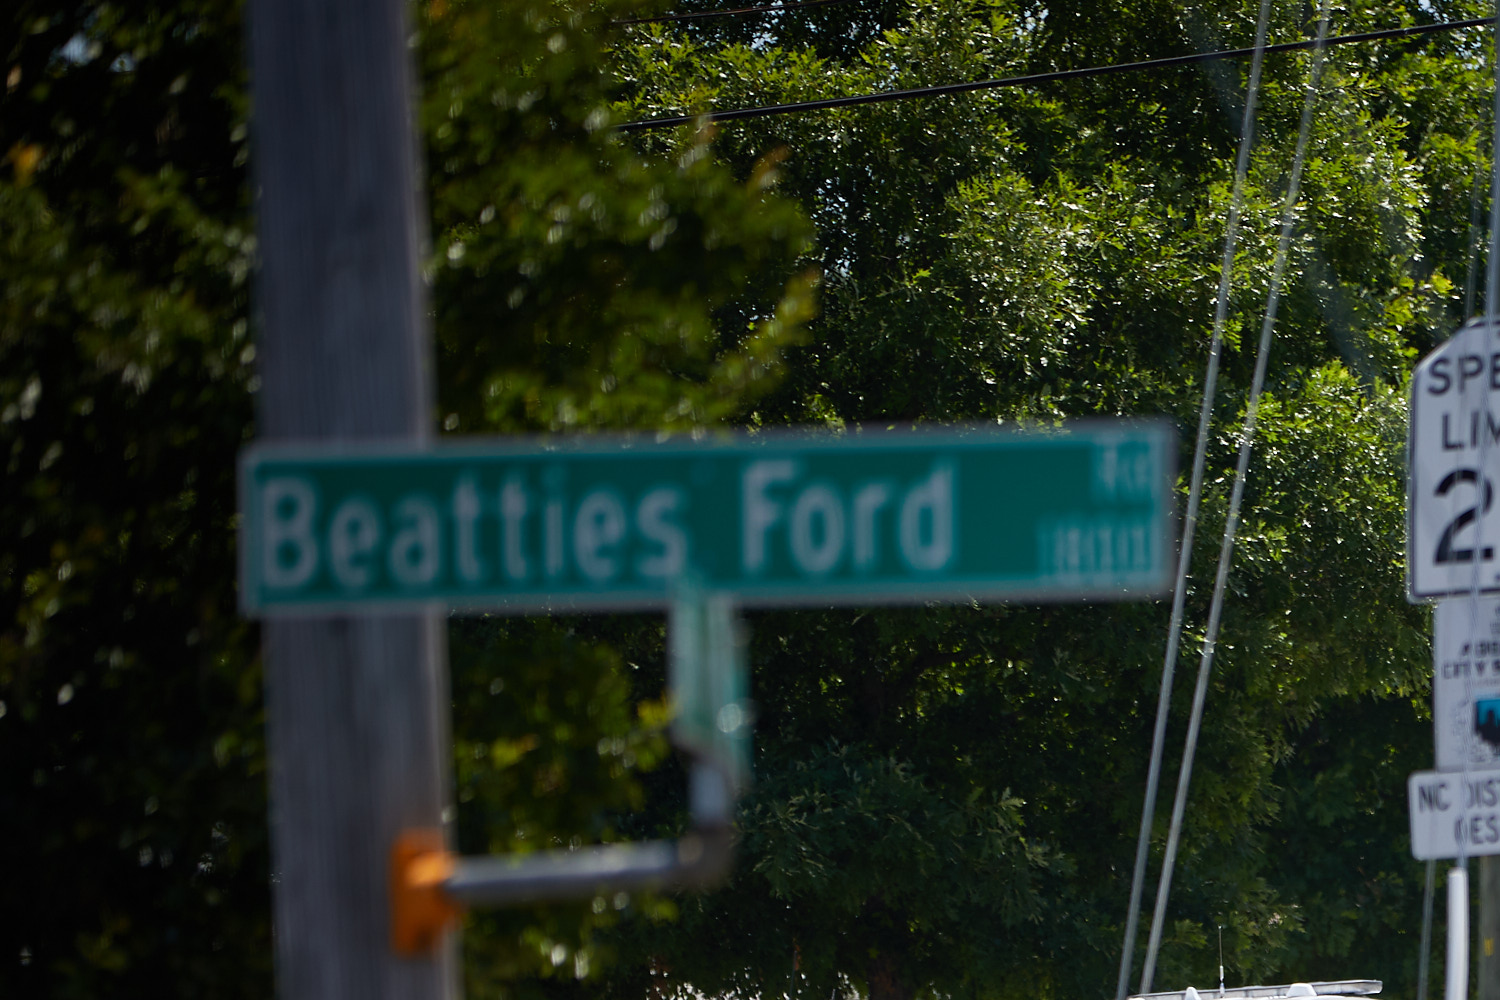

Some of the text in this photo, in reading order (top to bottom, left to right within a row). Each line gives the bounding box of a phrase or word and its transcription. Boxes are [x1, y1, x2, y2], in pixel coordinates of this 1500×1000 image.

[258, 474, 685, 590] Beatties
[741, 457, 956, 574] Ford
[1418, 784, 1450, 812] NC
